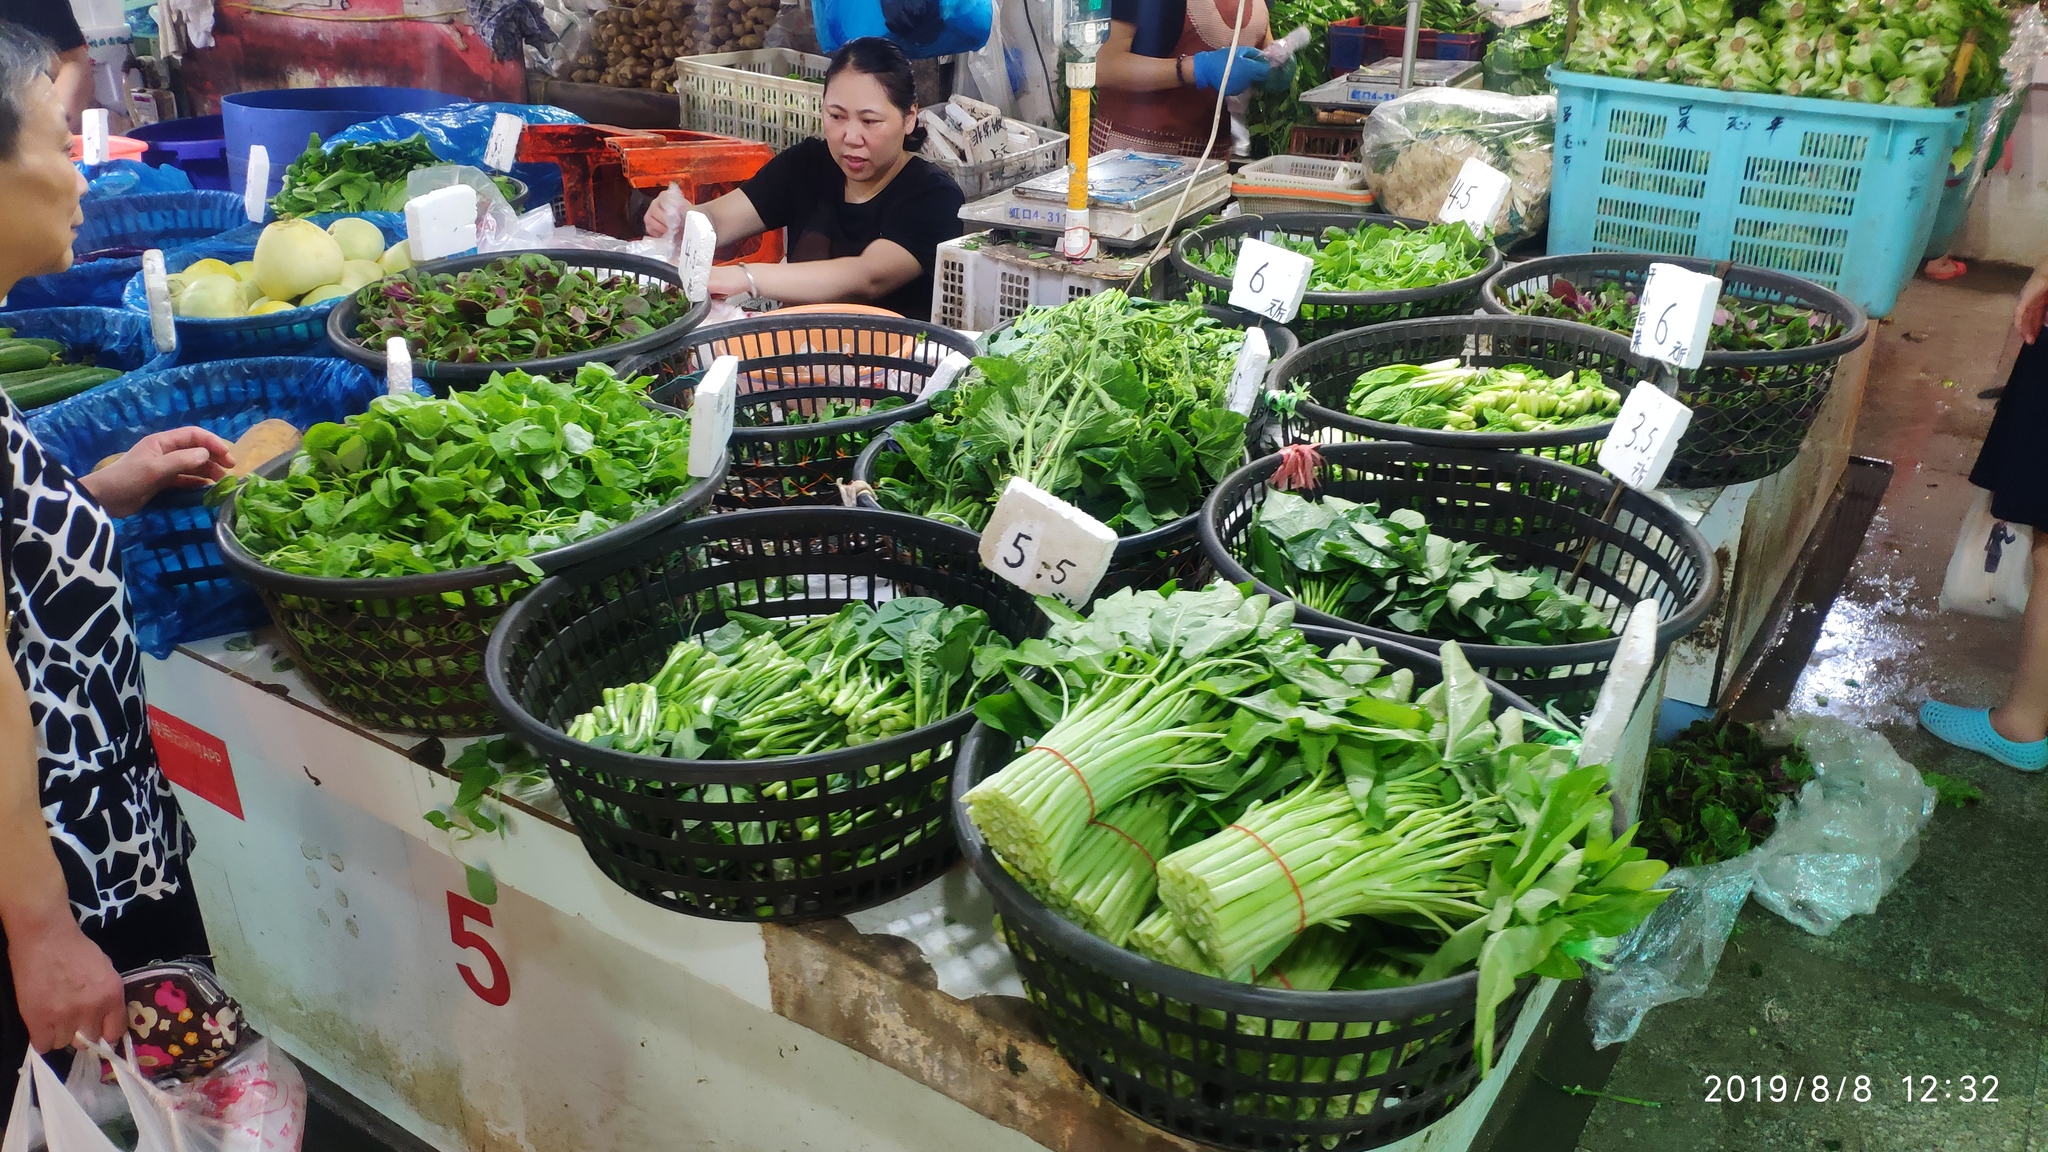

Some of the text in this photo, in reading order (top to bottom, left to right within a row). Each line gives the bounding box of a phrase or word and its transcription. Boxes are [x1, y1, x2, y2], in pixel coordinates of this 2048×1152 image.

[1447, 178, 1479, 210] 4.5
[1249, 261, 1269, 294] 6
[1655, 302, 1678, 346] 6
[1623, 412, 1659, 455] 3.5
[445, 889, 511, 1007] 5
